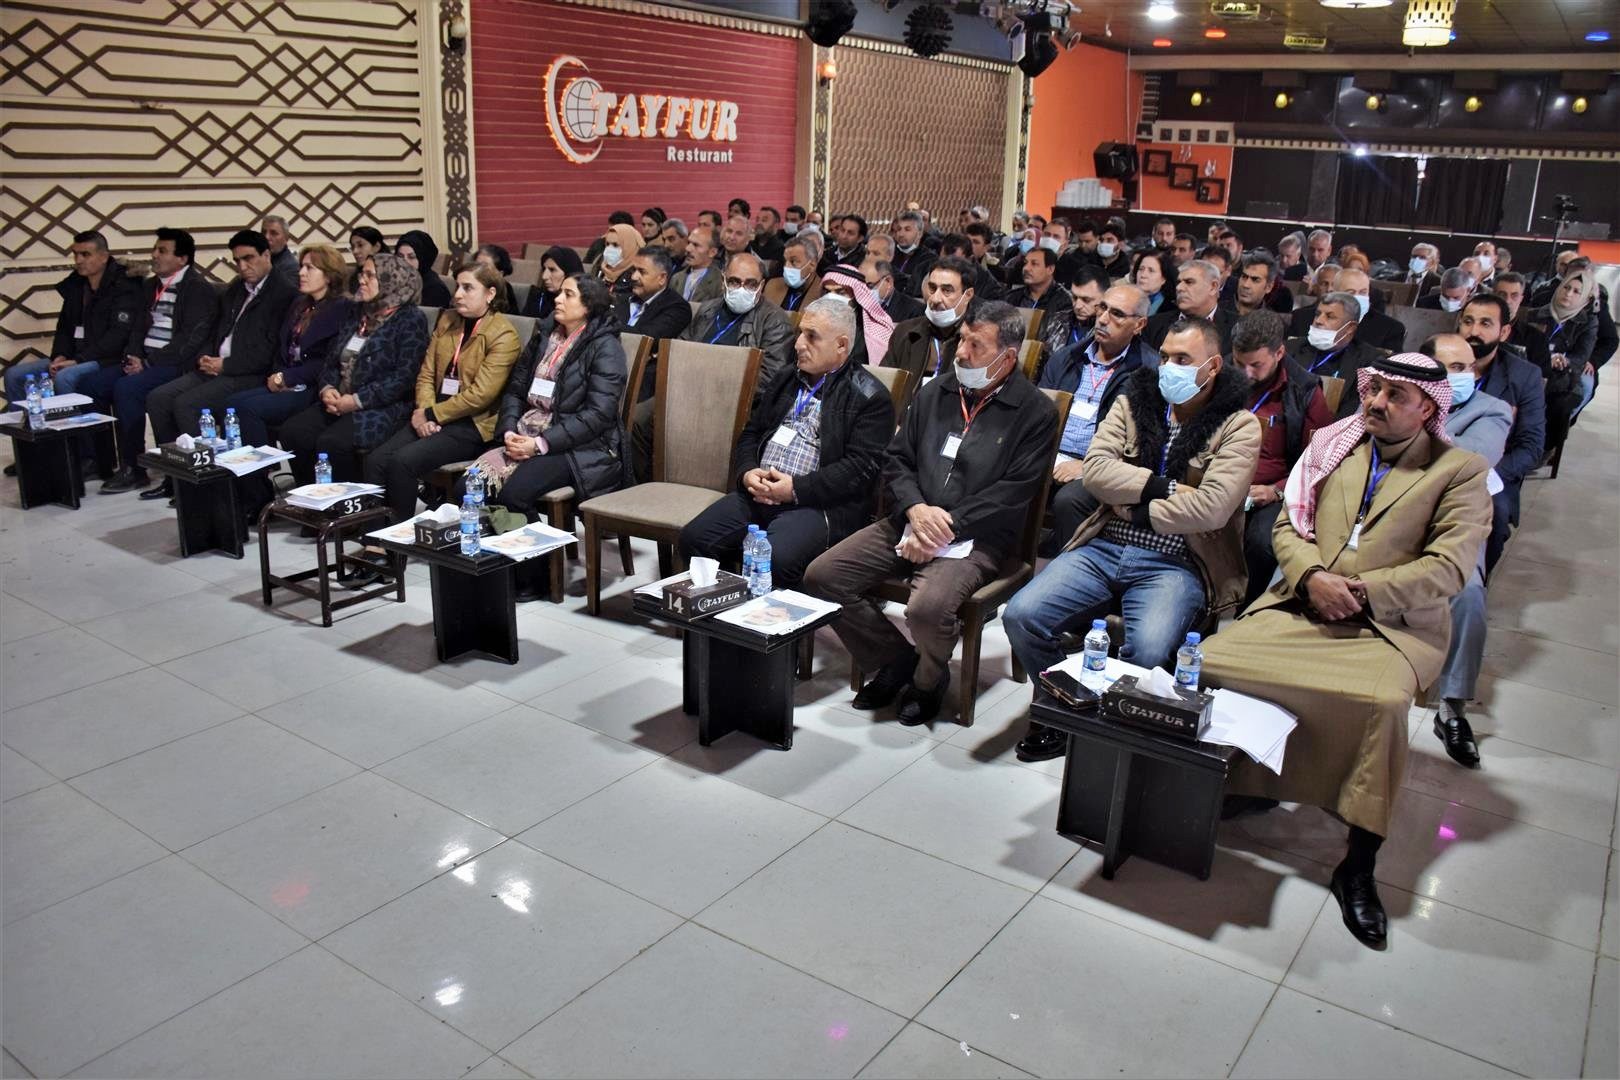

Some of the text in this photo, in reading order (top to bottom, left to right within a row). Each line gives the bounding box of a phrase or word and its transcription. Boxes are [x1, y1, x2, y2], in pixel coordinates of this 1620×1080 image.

[592, 92, 738, 140] TAYFUR
[667, 146, 732, 163] Resturant
[192, 450, 211, 466] 25
[344, 498, 362, 514] 35
[420, 528, 433, 545] 15
[668, 593, 684, 614] 14
[705, 592, 740, 607] TAYFUR
[1130, 705, 1184, 727] TAYFUR
